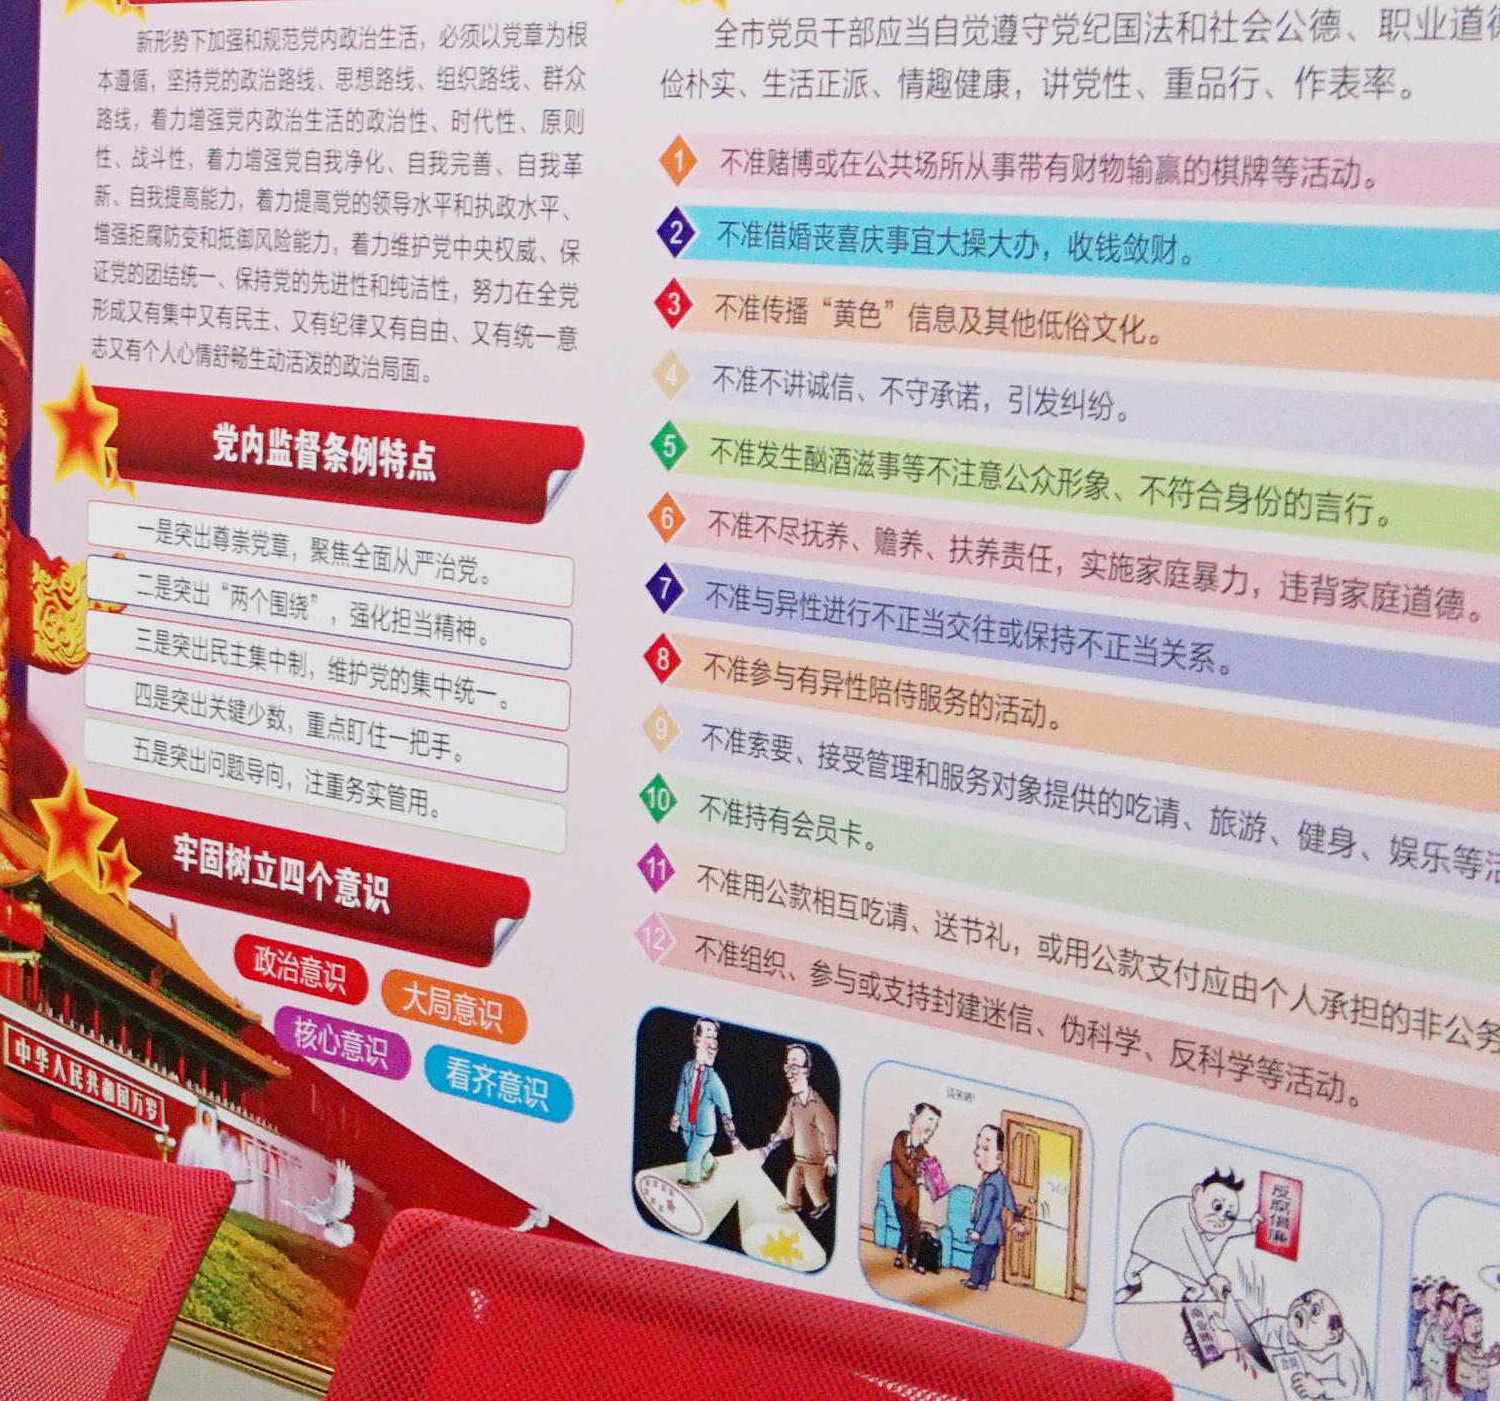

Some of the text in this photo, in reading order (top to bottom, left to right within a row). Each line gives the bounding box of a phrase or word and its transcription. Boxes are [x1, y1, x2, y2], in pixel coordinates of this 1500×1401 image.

[659, 63, 1413, 102] 俭朴实、生活正派、情趣健康，讲党性、重品行、作表率。
[672, 147, 1376, 191] 1 不准赌博或在公共场所从事带有财物输赢的棋牌等活动。
[669, 219, 1192, 267] 2 不准借婚丧喜庆事宜大操大办，收钱敛财。
[666, 291, 1160, 347] 3 不准传播“黄色”信息及其他低俗文化。
[663, 363, 1128, 423] 4 不准不讲诚信、不守承诺，引发纠纷。
[212, 421, 437, 483] 党内监督条例特点
[662, 434, 1388, 527] 5 不准发生酗酒滋事等不注意公众形象、不符合身份的言行。
[137, 516, 491, 587] 一是突出尊崇党章，聚焦全面从严治党。
[660, 507, 1480, 623] 6 不准不尽抚养、赡养、扶养责任，实施家庭暴力，违背家庭道德。
[136, 571, 488, 648] 二是突出“两个围绕”，强化担当精神。
[657, 576, 1230, 677] 7 不准与异性进行不正当交往或保持不正当关系。
[134, 627, 508, 711] 三是突出民主集中制，维护党的集中统一。
[656, 646, 1062, 732] 8 不准参与有异性陪侍服务的活动。
[133, 681, 462, 764] 四是突出关键少数，重点盯住一把手。
[654, 716, 669, 741] 9
[132, 735, 440, 820] 五是突出问题导向，注重务实管用。
[645, 786, 876, 852] 10 不准持有会员卡。
[172, 831, 391, 916] 牢固树立四个意识
[253, 944, 348, 996] 政治意识
[645, 857, 1500, 1055] 11 不准用公款相互吃请、送节礼，或用公款支付应由个人承担的非公务
[402, 979, 504, 1034] 大局意识
[639, 925, 1360, 1109] 12 不准组织、参与或支持封建迷信、伪科学、反科学等活动。
[293, 1015, 389, 1070] 核心意识
[14, 1036, 160, 1124] 中华人民共和国万岁
[446, 1055, 550, 1114] 看齐意识
